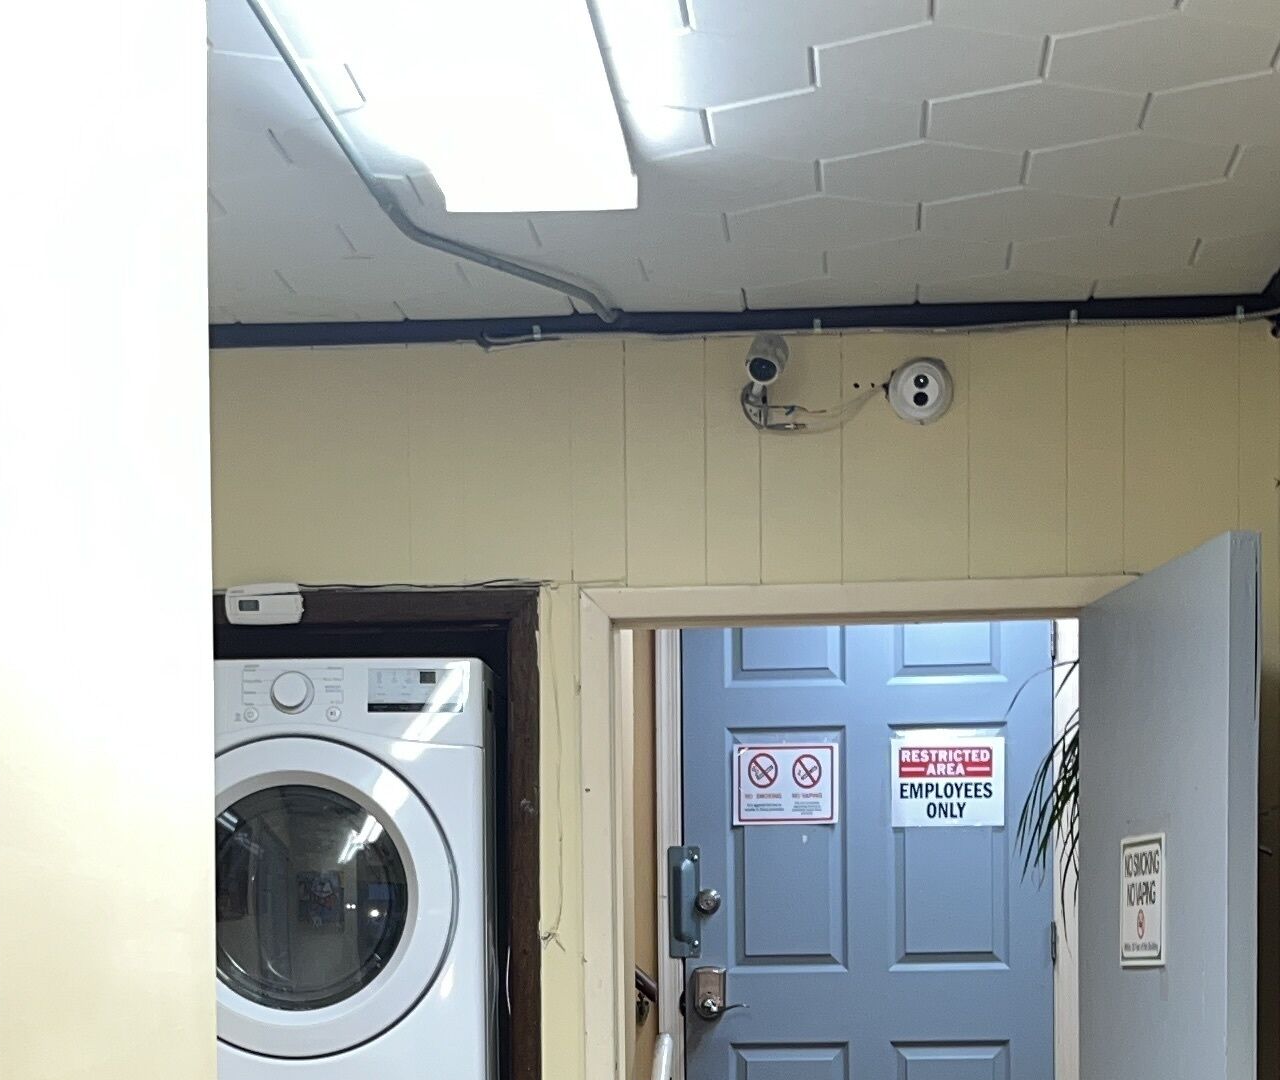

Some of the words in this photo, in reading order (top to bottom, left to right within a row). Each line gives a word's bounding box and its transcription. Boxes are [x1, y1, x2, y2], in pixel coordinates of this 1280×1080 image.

[901, 749, 991, 762] RESTRICTED
[926, 763, 966, 776] AREA
[900, 782, 993, 799] EMPLOYEES
[926, 801, 966, 819] ONLY
[1125, 854, 1133, 877] NO
[1133, 850, 1160, 876] SMOKING
[1127, 883, 1135, 906] NO
[1135, 880, 1156, 906] VAPING
